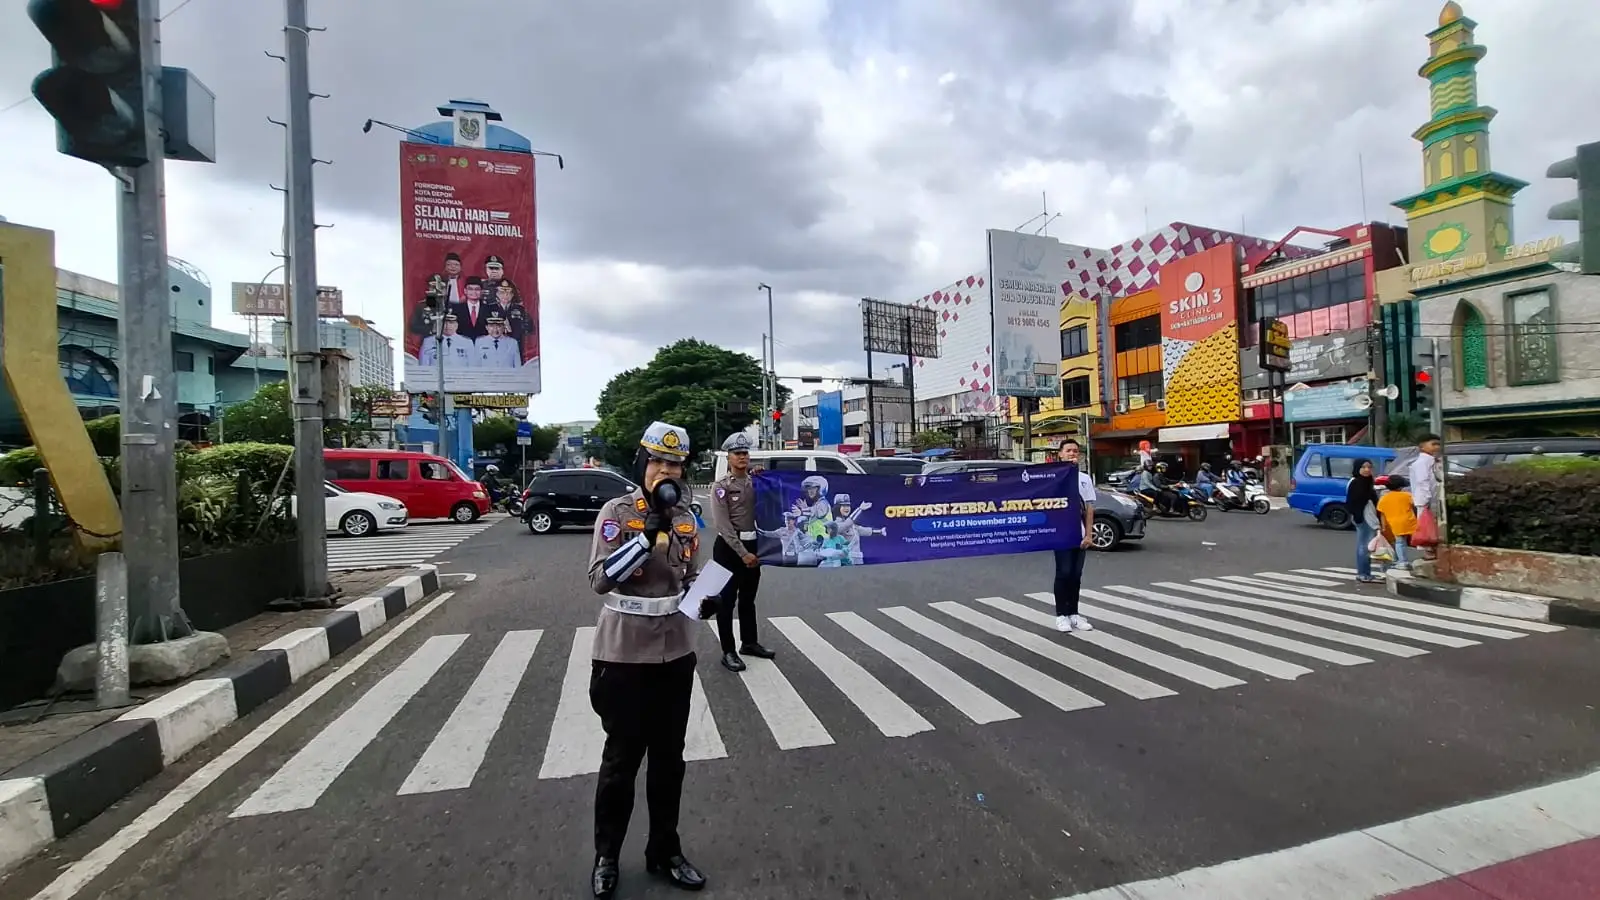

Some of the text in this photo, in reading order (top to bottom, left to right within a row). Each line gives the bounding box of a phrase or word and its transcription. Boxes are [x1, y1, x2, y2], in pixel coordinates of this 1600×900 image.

[414, 189, 430, 197] KOTA
[414, 196, 463, 205] MENGUCAPKAN
[414, 204, 489, 222] SELAMAT HARI
[415, 217, 523, 238] PAHLAWAN NASIONAL
[423, 232, 455, 240] NOVEMBER
[1169, 287, 1223, 315] SKIN 3
[1180, 306, 1212, 319] CLINIC
[477, 395, 498, 406] KOTA
[499, 395, 528, 407] DEPOK
[885, 497, 1068, 518] OPERASI ZEBRA JAYA 2025
[931, 520, 941, 529] 17
[955, 518, 966, 527] 30
[966, 516, 1006, 527] November
[1007, 515, 1027, 525] 2025
